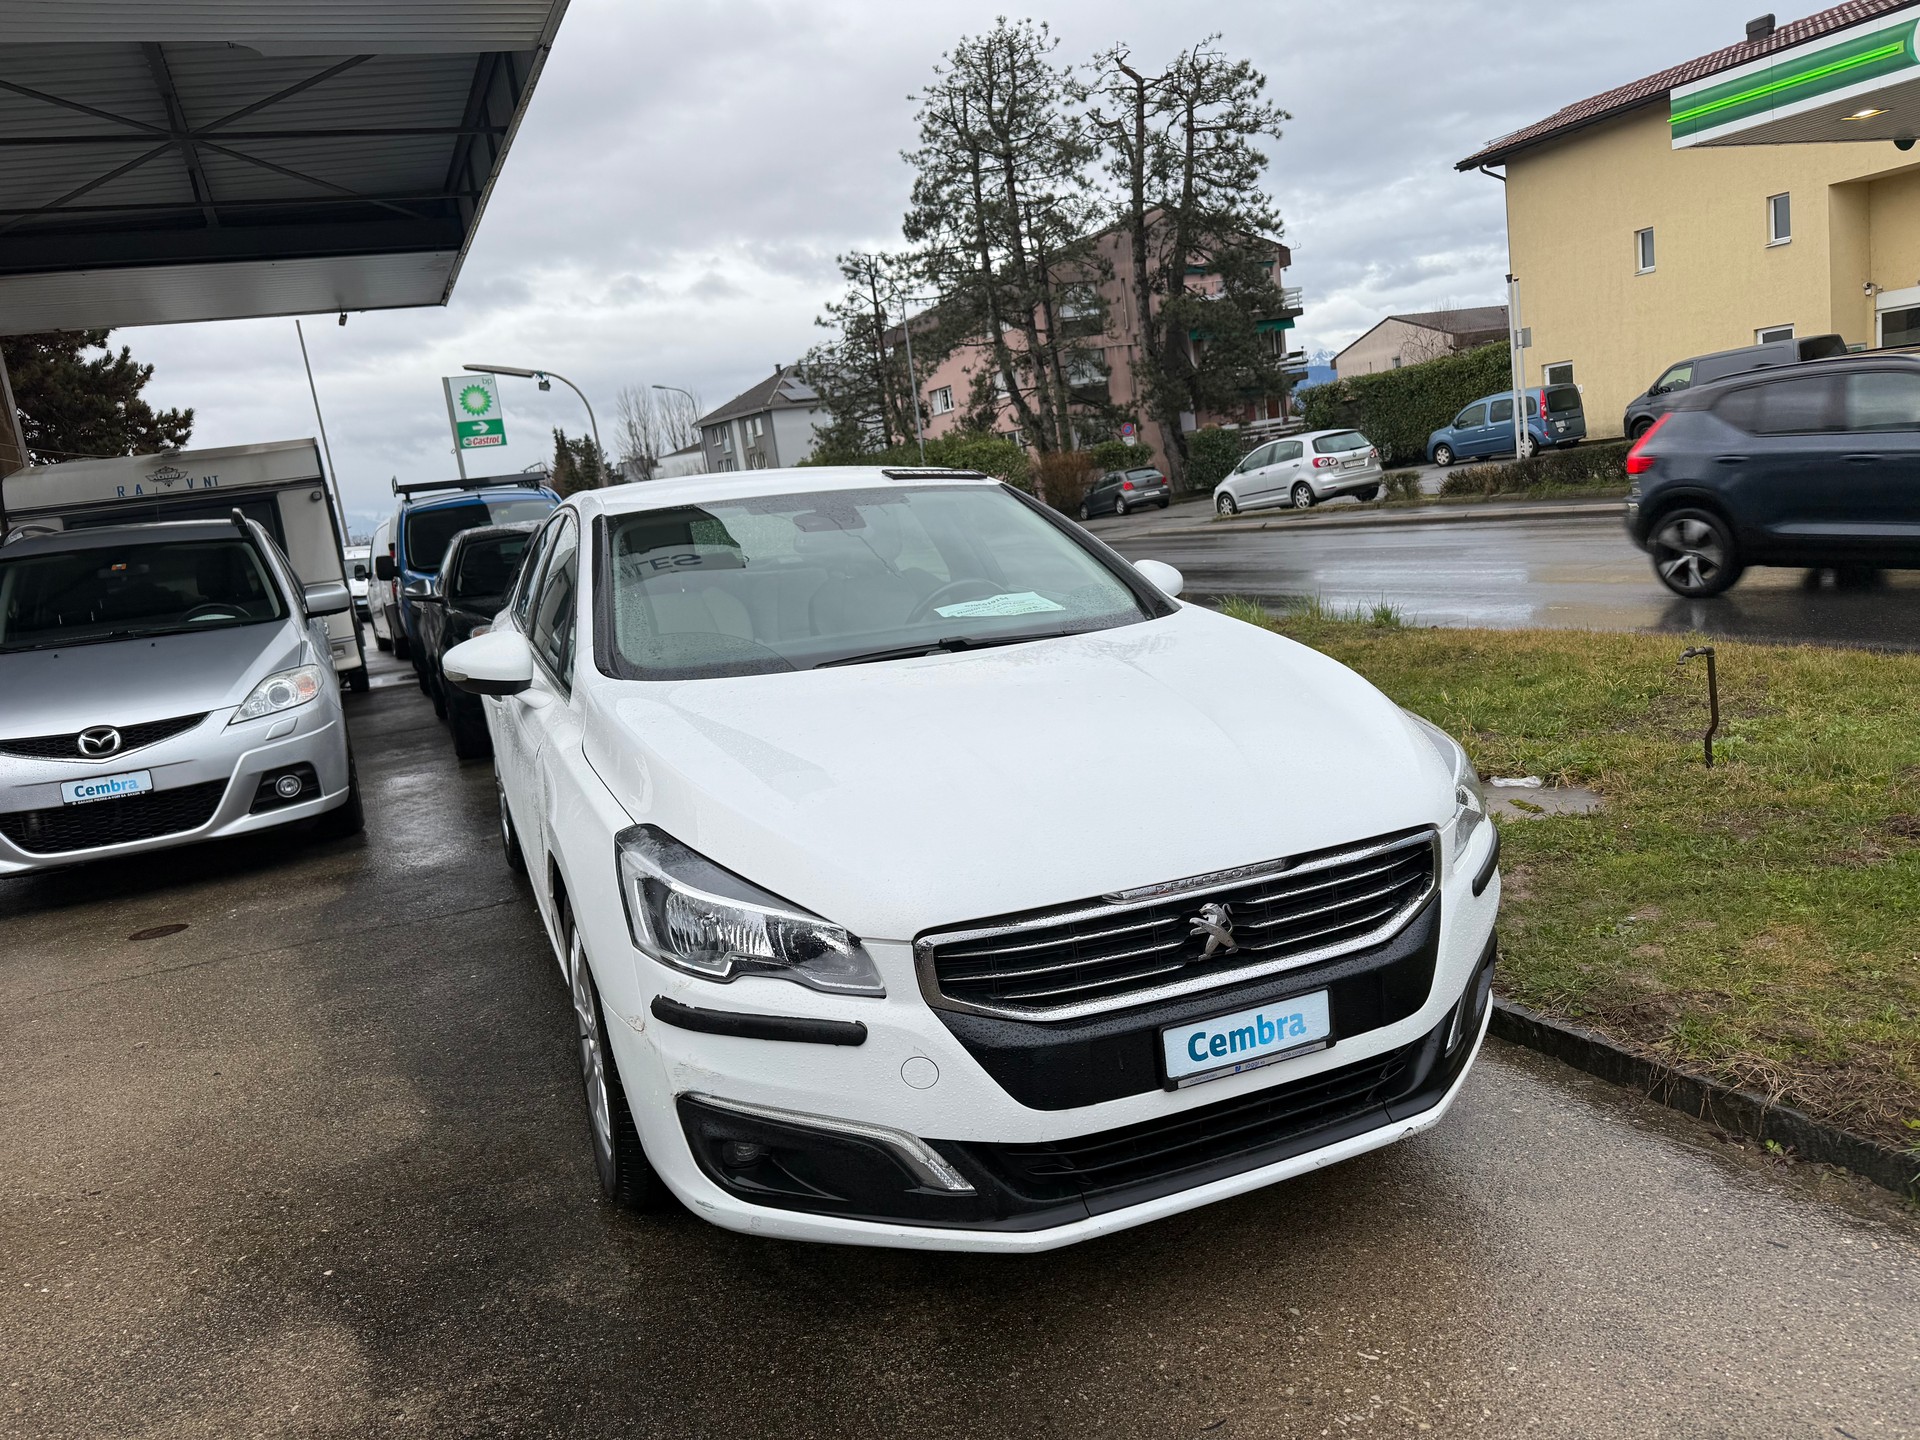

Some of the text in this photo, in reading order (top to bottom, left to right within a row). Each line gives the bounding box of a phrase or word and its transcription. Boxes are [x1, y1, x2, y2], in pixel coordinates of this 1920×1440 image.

[481, 377, 493, 385] bp
[472, 435, 500, 446] Castrol
[74, 779, 139, 797] Cembra
[1155, 866, 1255, 894] PEUGEOT
[1187, 1013, 1307, 1062] Cembra
